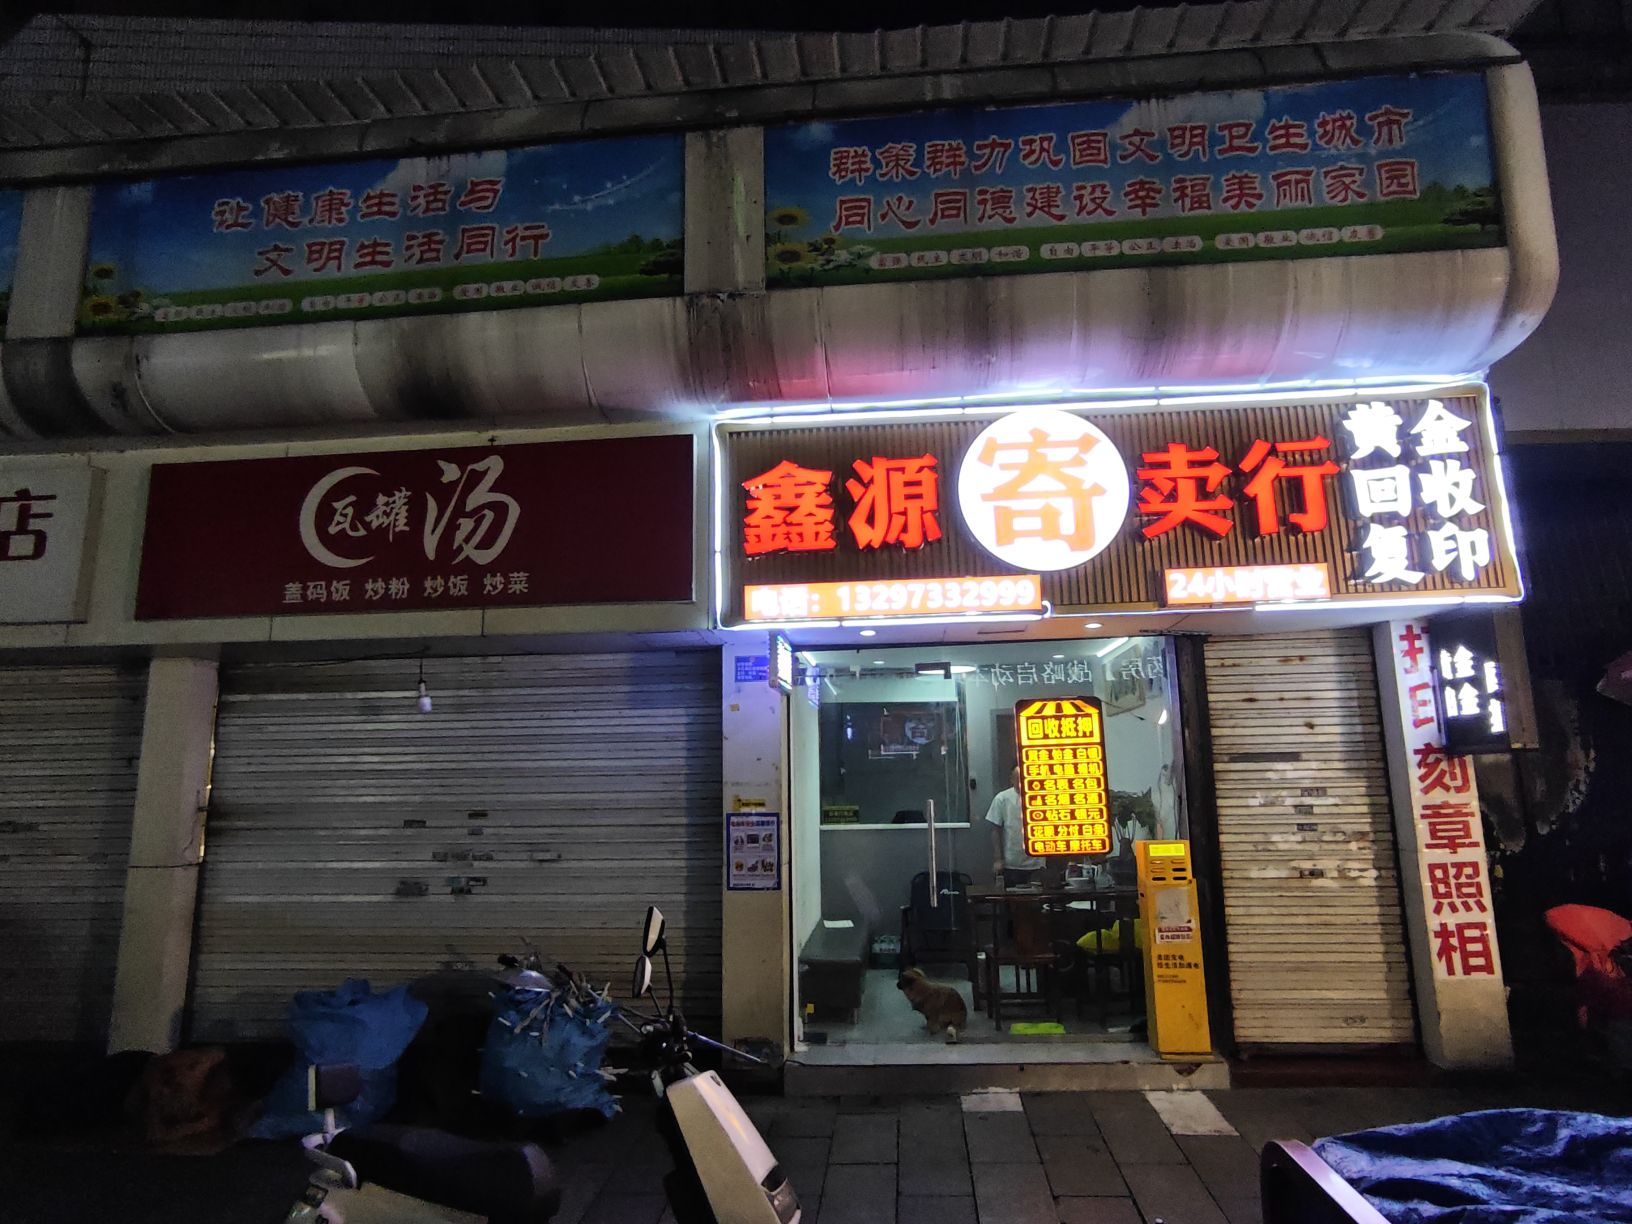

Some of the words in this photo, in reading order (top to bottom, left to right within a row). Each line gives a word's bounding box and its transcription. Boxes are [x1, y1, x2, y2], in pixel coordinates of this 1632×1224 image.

[831, 105, 1411, 184] 群策群力巩固文明卫生城市
[213, 178, 502, 230] 让健康生活与
[833, 160, 1417, 232] 同心同德建设幸福美丽家园
[254, 224, 549, 277] 文明生活同行
[1343, 400, 1472, 459] 黄金
[328, 455, 521, 565] 瓦罐汤
[743, 428, 1340, 555] 鑫源寄卖行
[1350, 459, 1485, 518] 回收
[0, 488, 57, 561] 店
[1363, 522, 1489, 584] 复印
[282, 579, 351, 603] 盖码饭
[365, 577, 410, 600] 炒粉
[424, 575, 469, 597] 炒饭
[483, 572, 530, 595] 炒菜
[835, 578, 1036, 613] 13297332999
[1028, 716, 1092, 738] 回收抵押
[1028, 764, 1050, 776] 手机
[1073, 778, 1098, 790] 名包
[1046, 809, 1070, 820] 钻石
[1034, 841, 1067, 853] 电动车
[1070, 840, 1103, 851] 摩托车
